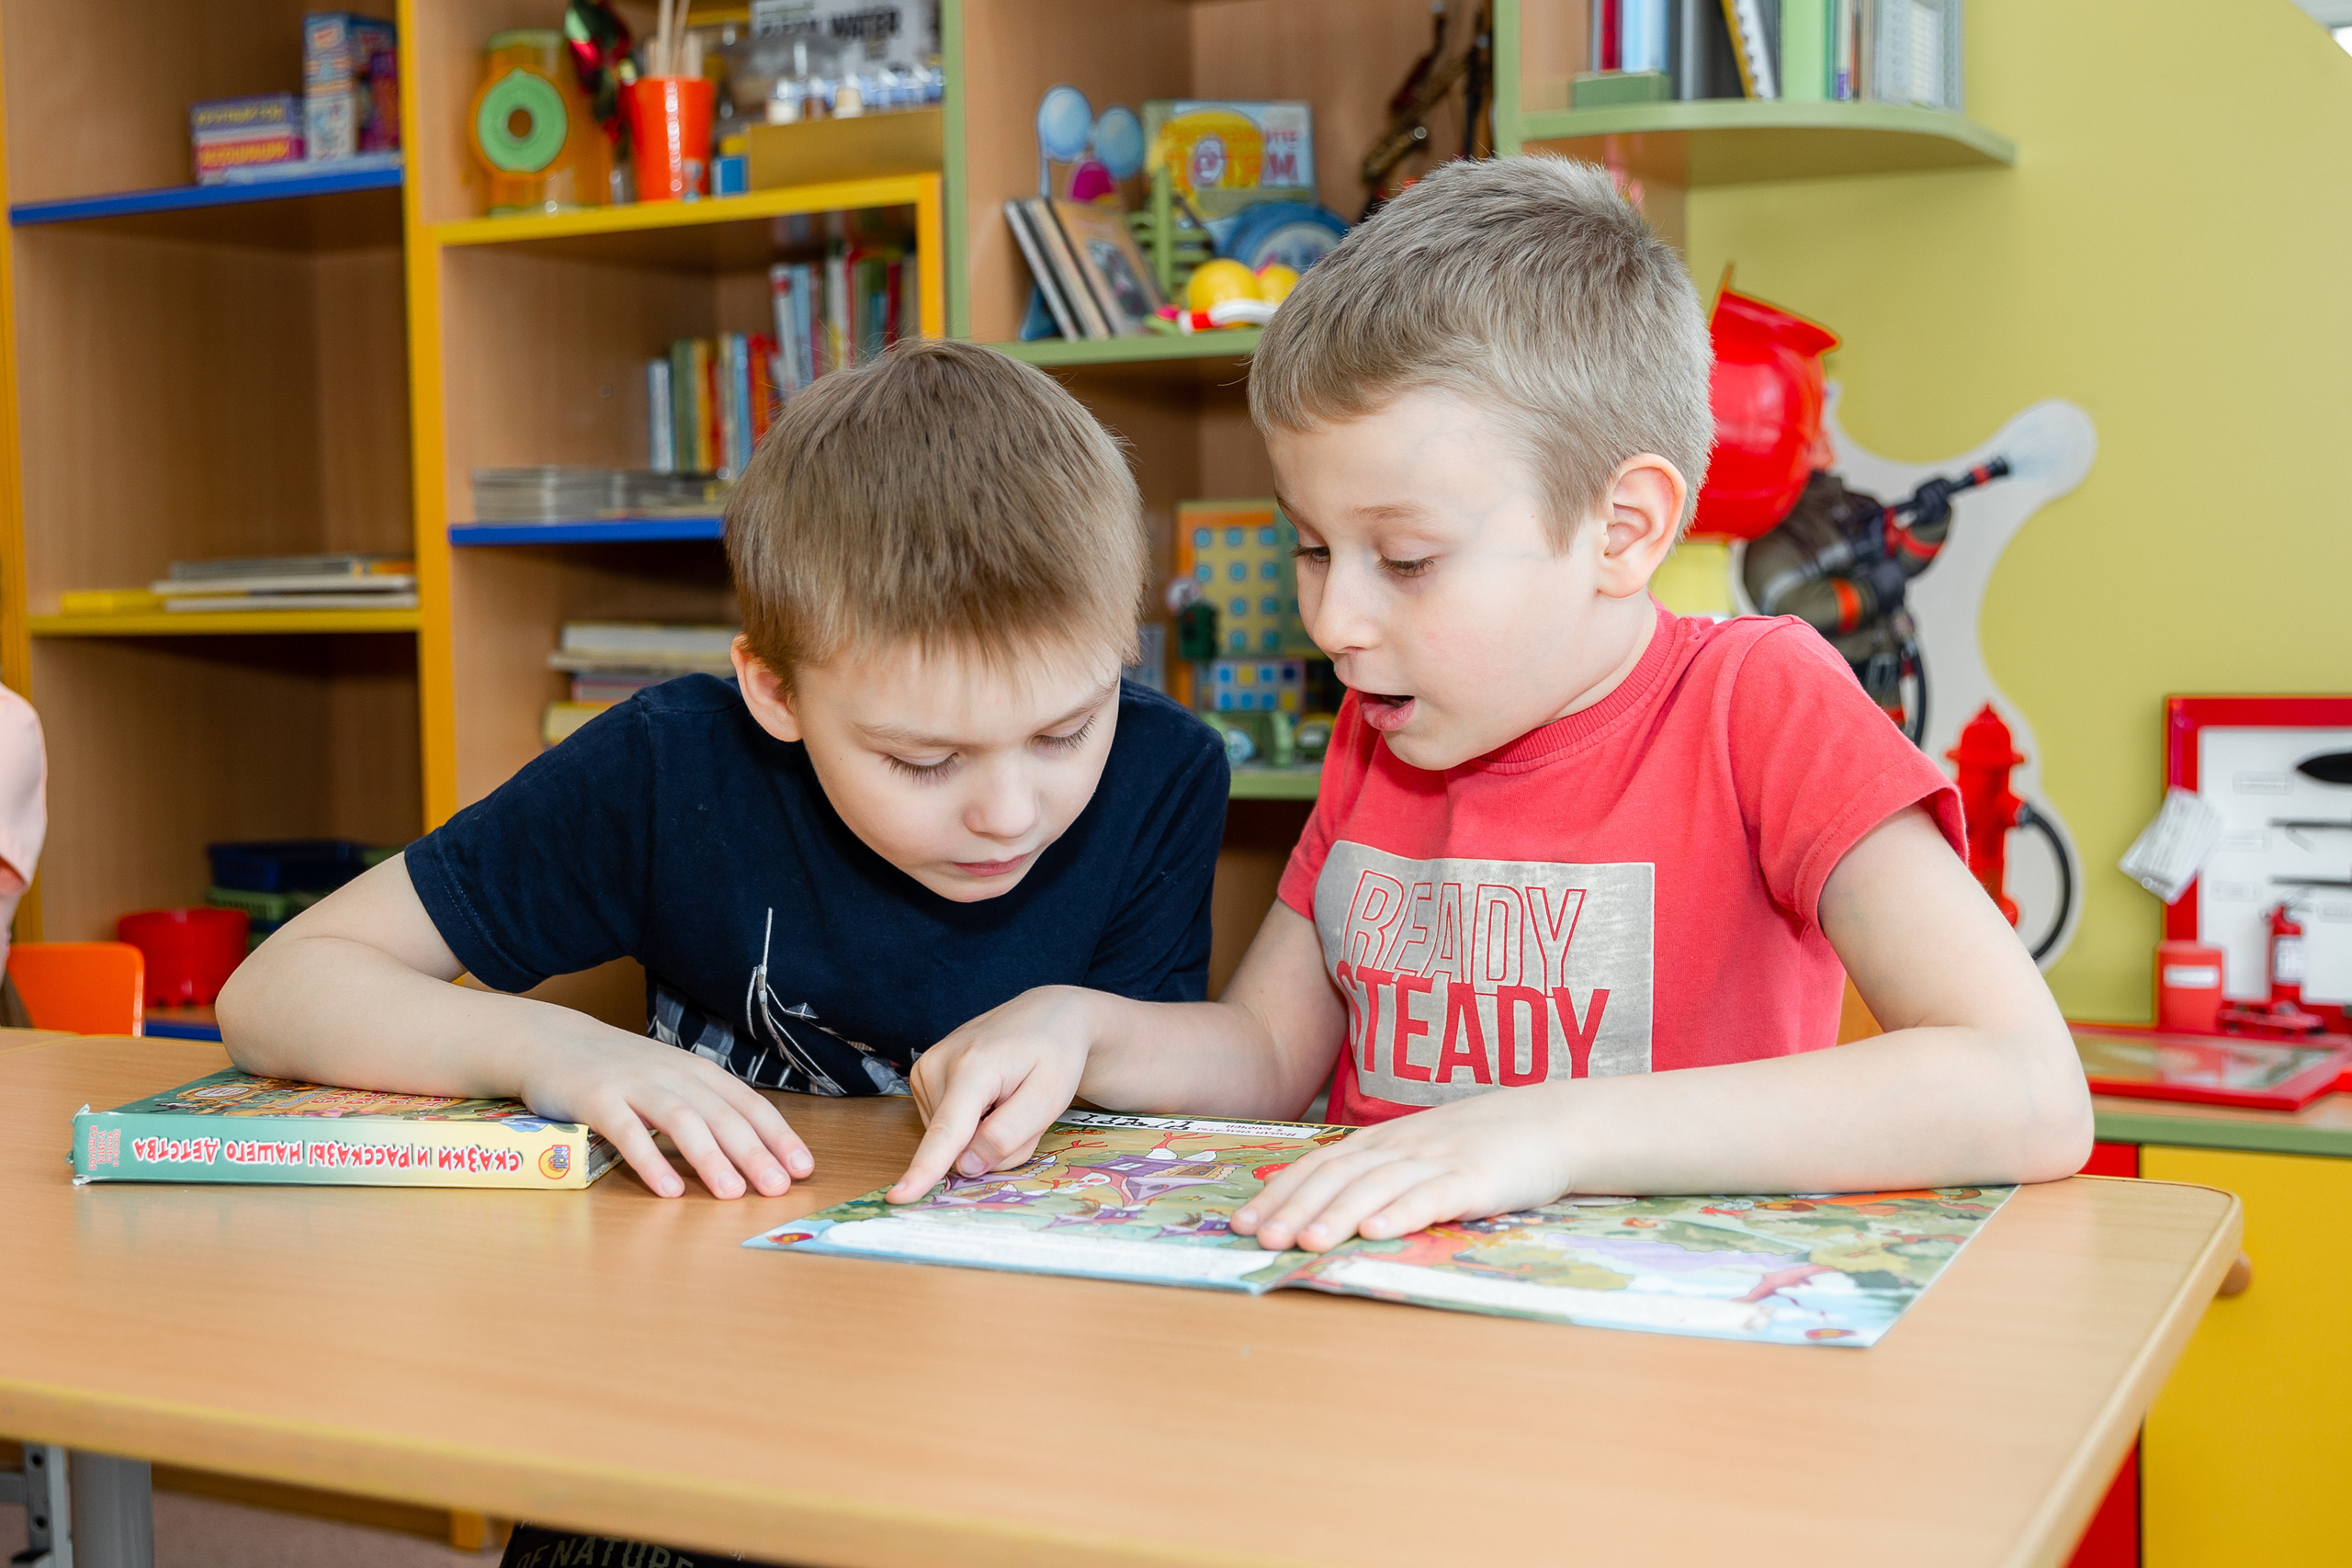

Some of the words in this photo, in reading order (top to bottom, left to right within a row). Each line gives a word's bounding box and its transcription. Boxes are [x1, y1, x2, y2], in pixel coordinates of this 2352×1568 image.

[1342, 869, 1587, 998] READY
[1336, 960, 1611, 1088] STEADY
[134, 1138, 219, 1164] ДЕТСТВА
[226, 1141, 304, 1165] НАШЕГО
[309, 1142, 413, 1168] РАССКАЗЫ
[417, 1147, 431, 1168] И
[437, 1145, 522, 1174] СКАЗКИ
